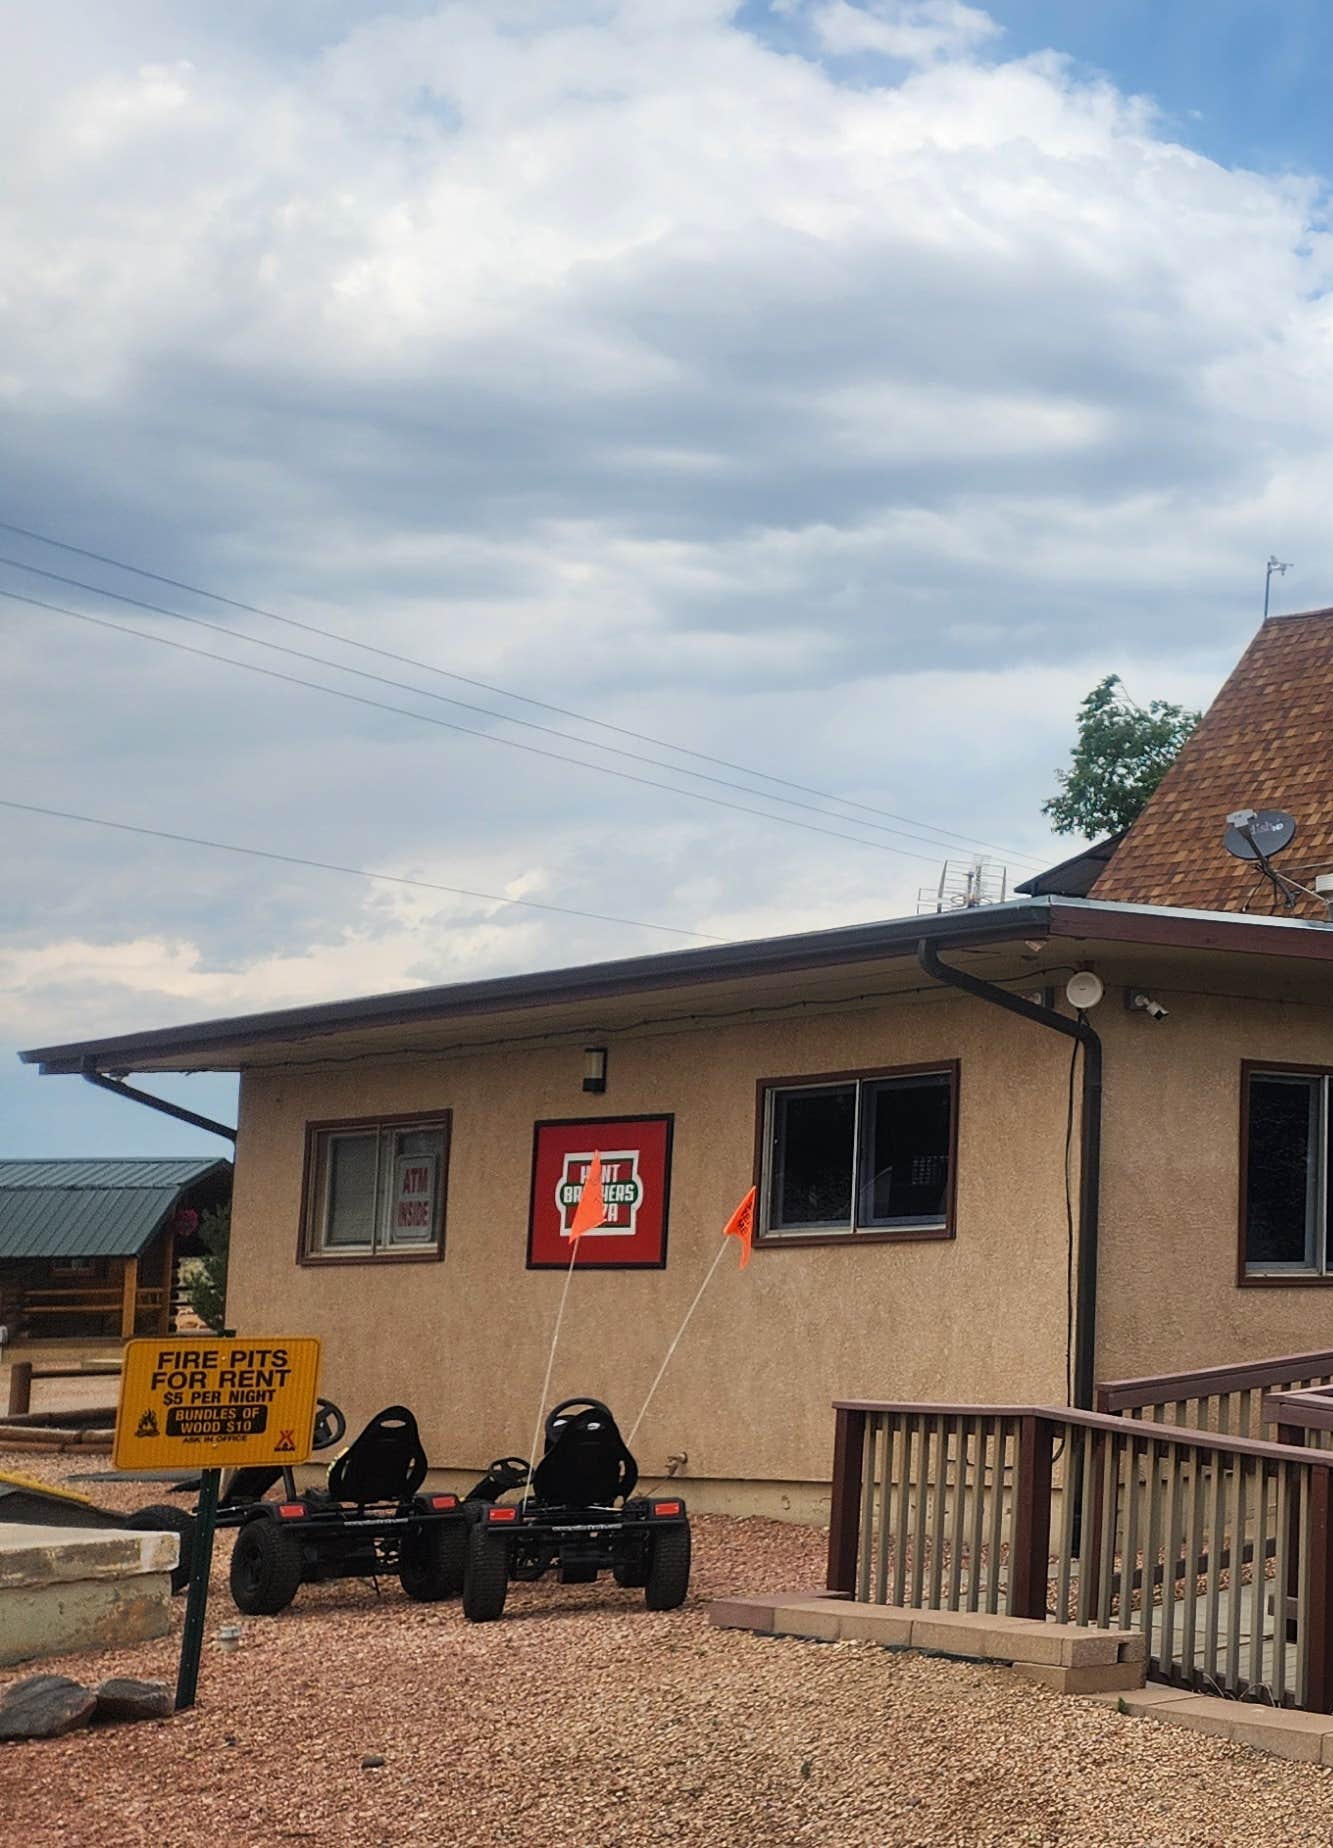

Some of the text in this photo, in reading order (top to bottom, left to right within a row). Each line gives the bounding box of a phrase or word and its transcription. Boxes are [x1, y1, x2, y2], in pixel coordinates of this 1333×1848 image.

[403, 1168, 428, 1193] ATM
[580, 1164, 621, 1184] HNT
[563, 1184, 634, 1203] BRHERS
[157, 1349, 288, 1369] FIRE PITS
[151, 1369, 291, 1390] FOR RENT
[163, 1389, 276, 1406] $5 PER NIGHT
[175, 1407, 260, 1421] BUNDLES OF
[181, 1421, 252, 1434] WOOD $10
